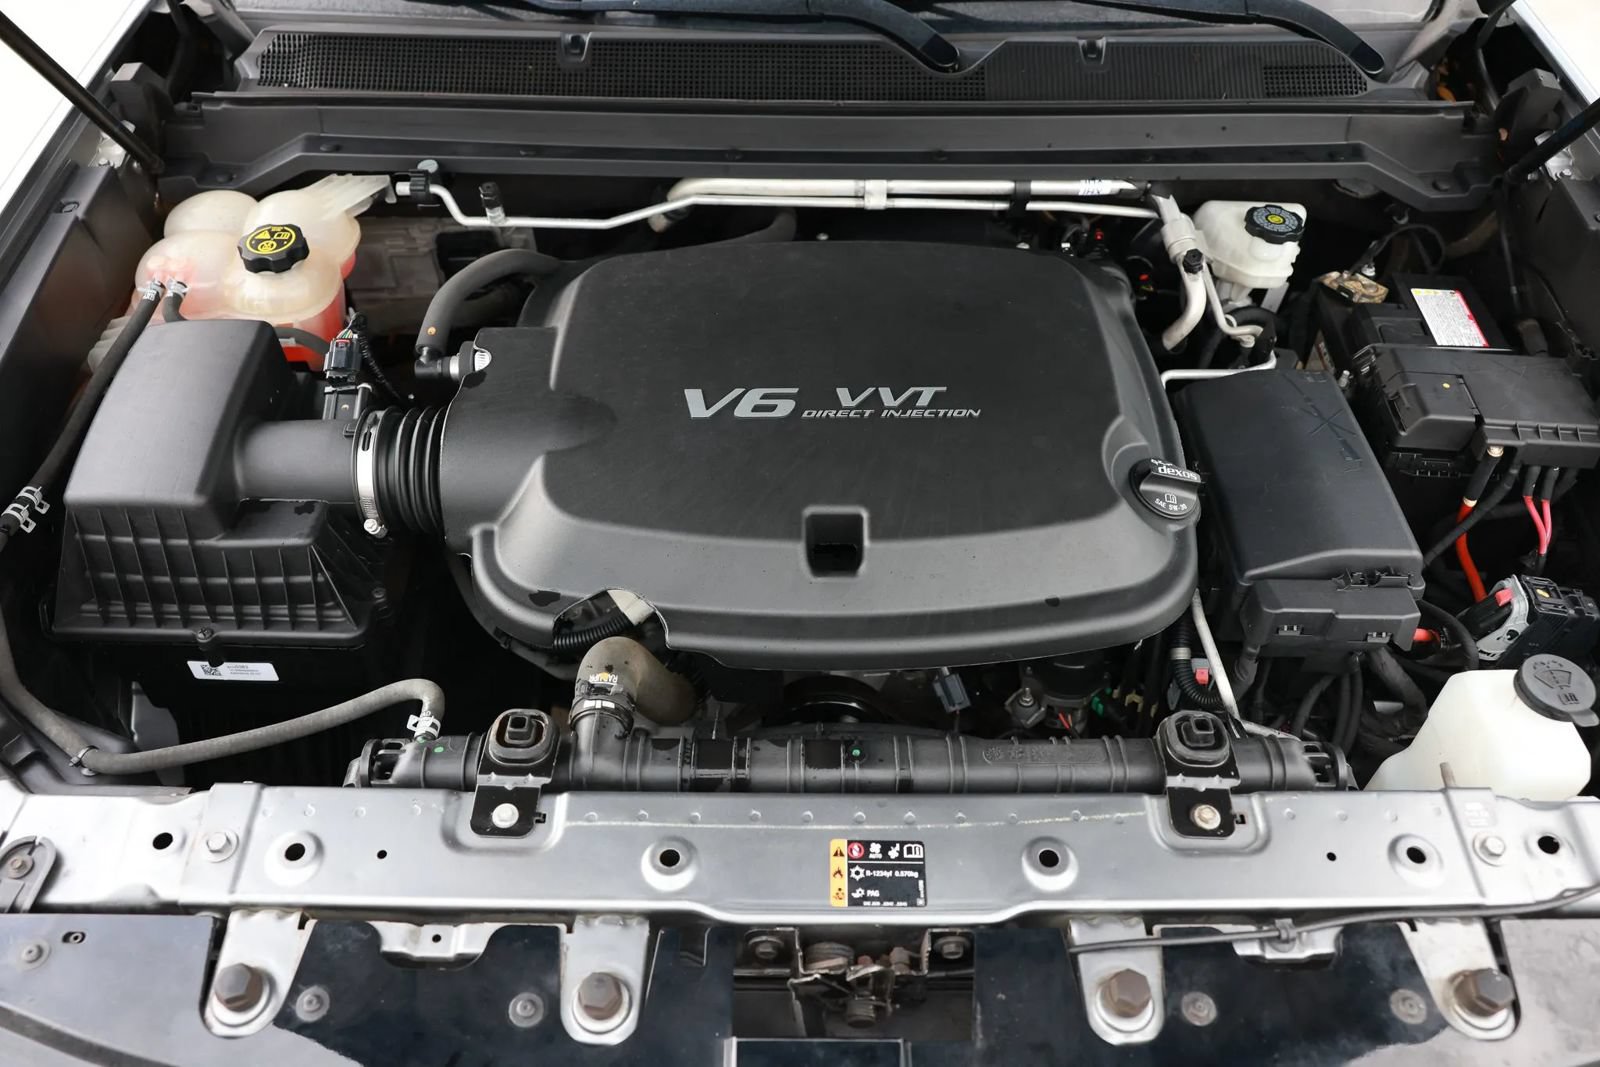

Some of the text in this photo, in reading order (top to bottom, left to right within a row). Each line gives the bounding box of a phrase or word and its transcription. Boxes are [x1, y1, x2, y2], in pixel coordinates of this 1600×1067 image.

[683, 386, 947, 419] V6 VVT
[801, 408, 982, 418] DIRECT INJECTION
[1157, 465, 1198, 481] dexos
[1154, 498, 1166, 508] SAE
[866, 889, 880, 898] PAG
